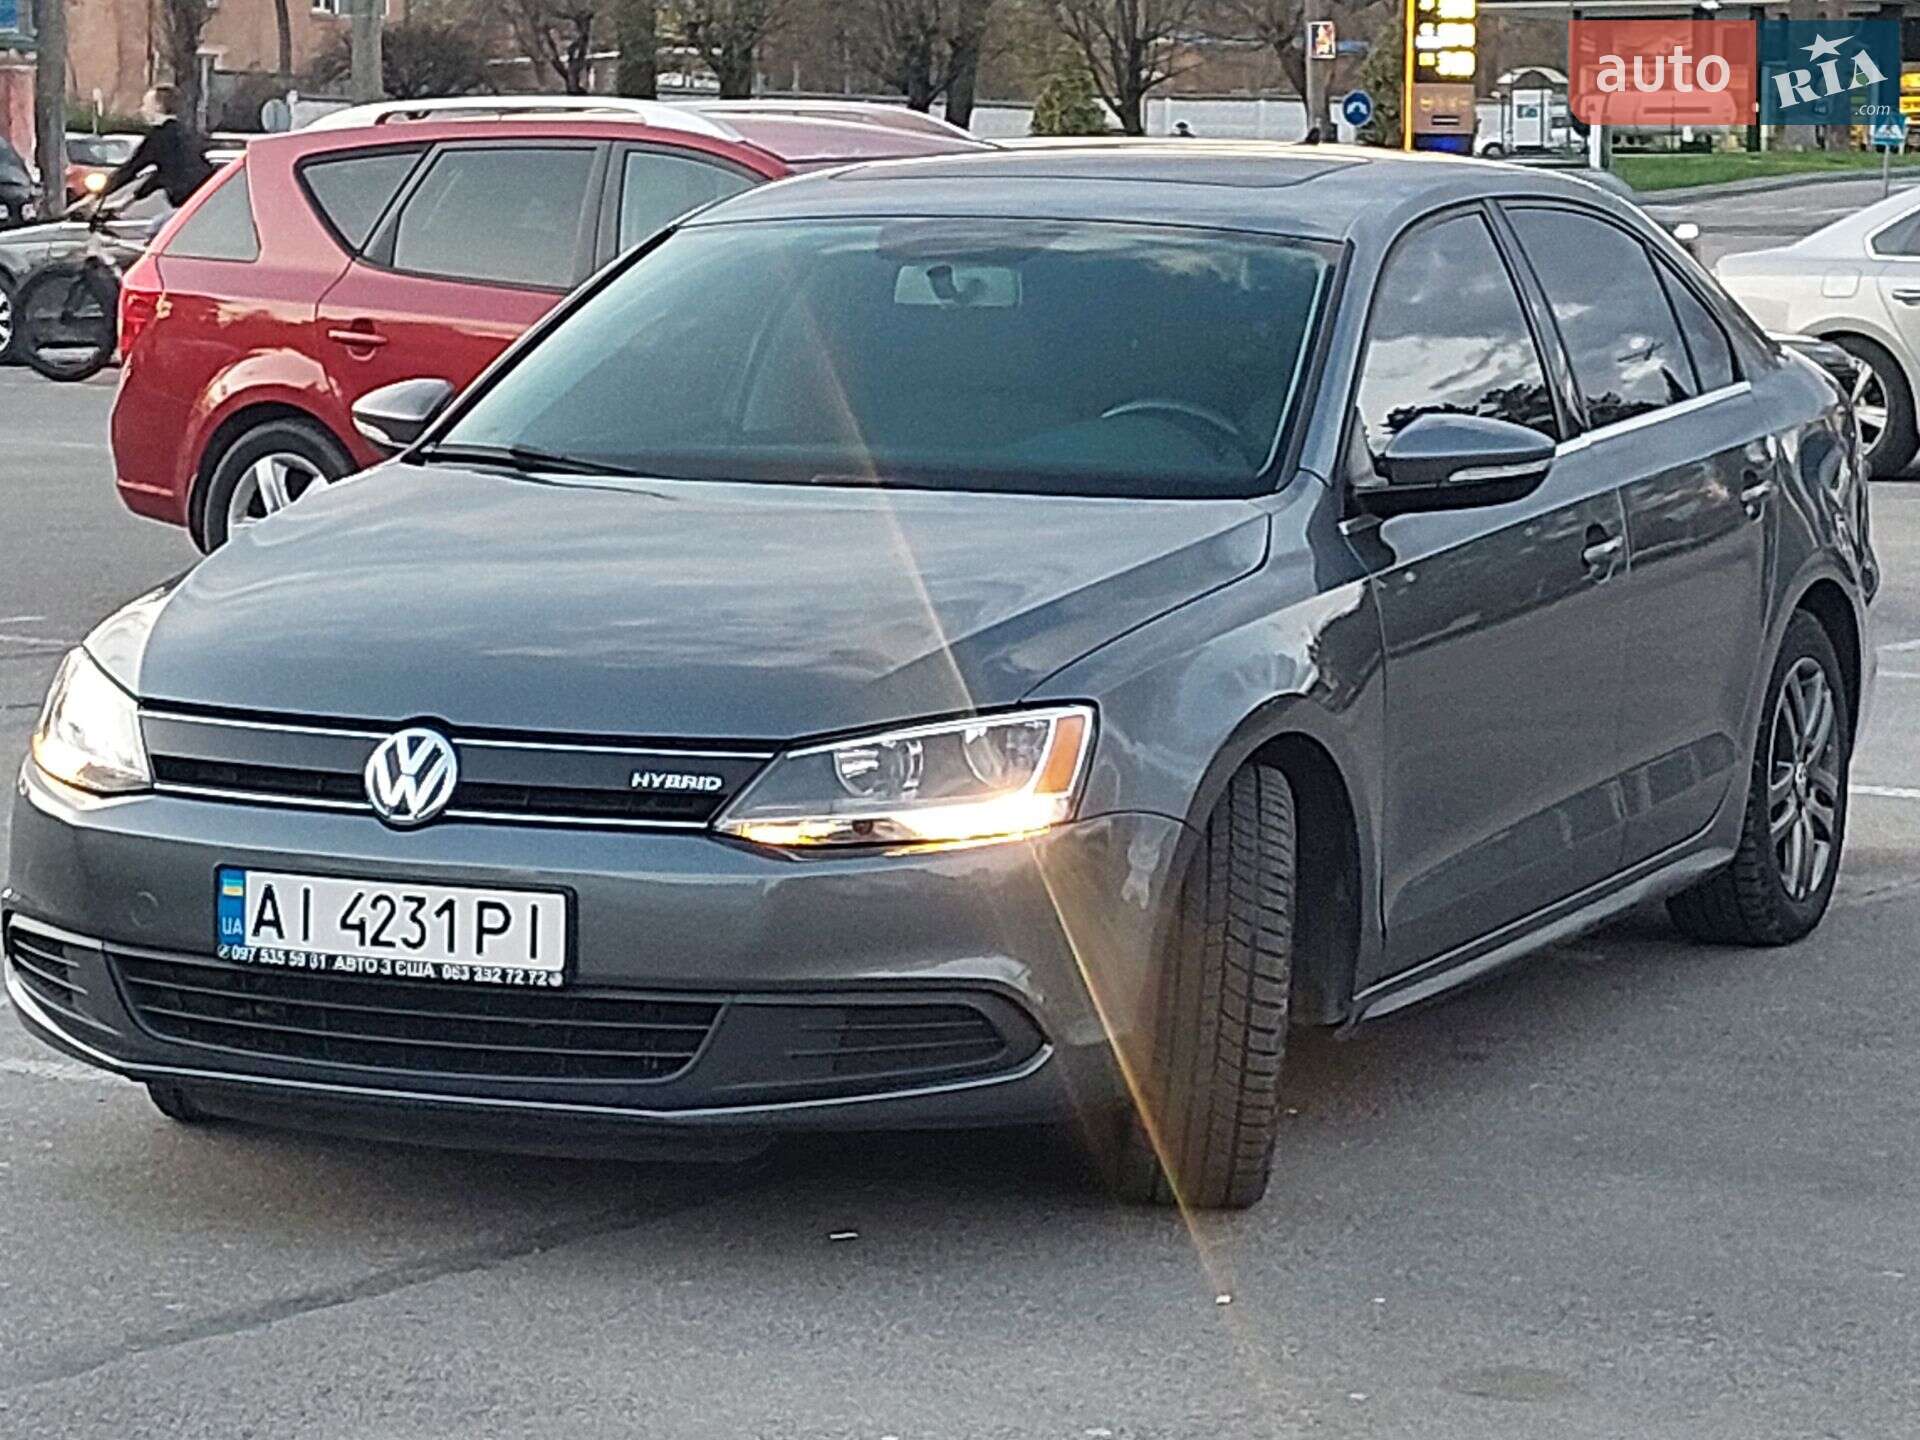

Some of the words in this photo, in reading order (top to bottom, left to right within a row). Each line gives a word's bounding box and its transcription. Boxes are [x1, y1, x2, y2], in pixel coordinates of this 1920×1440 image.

[631, 772, 723, 791] HYBRID
[221, 916, 243, 936] UA
[332, 957, 378, 973] АВТО
[395, 960, 436, 978] США
